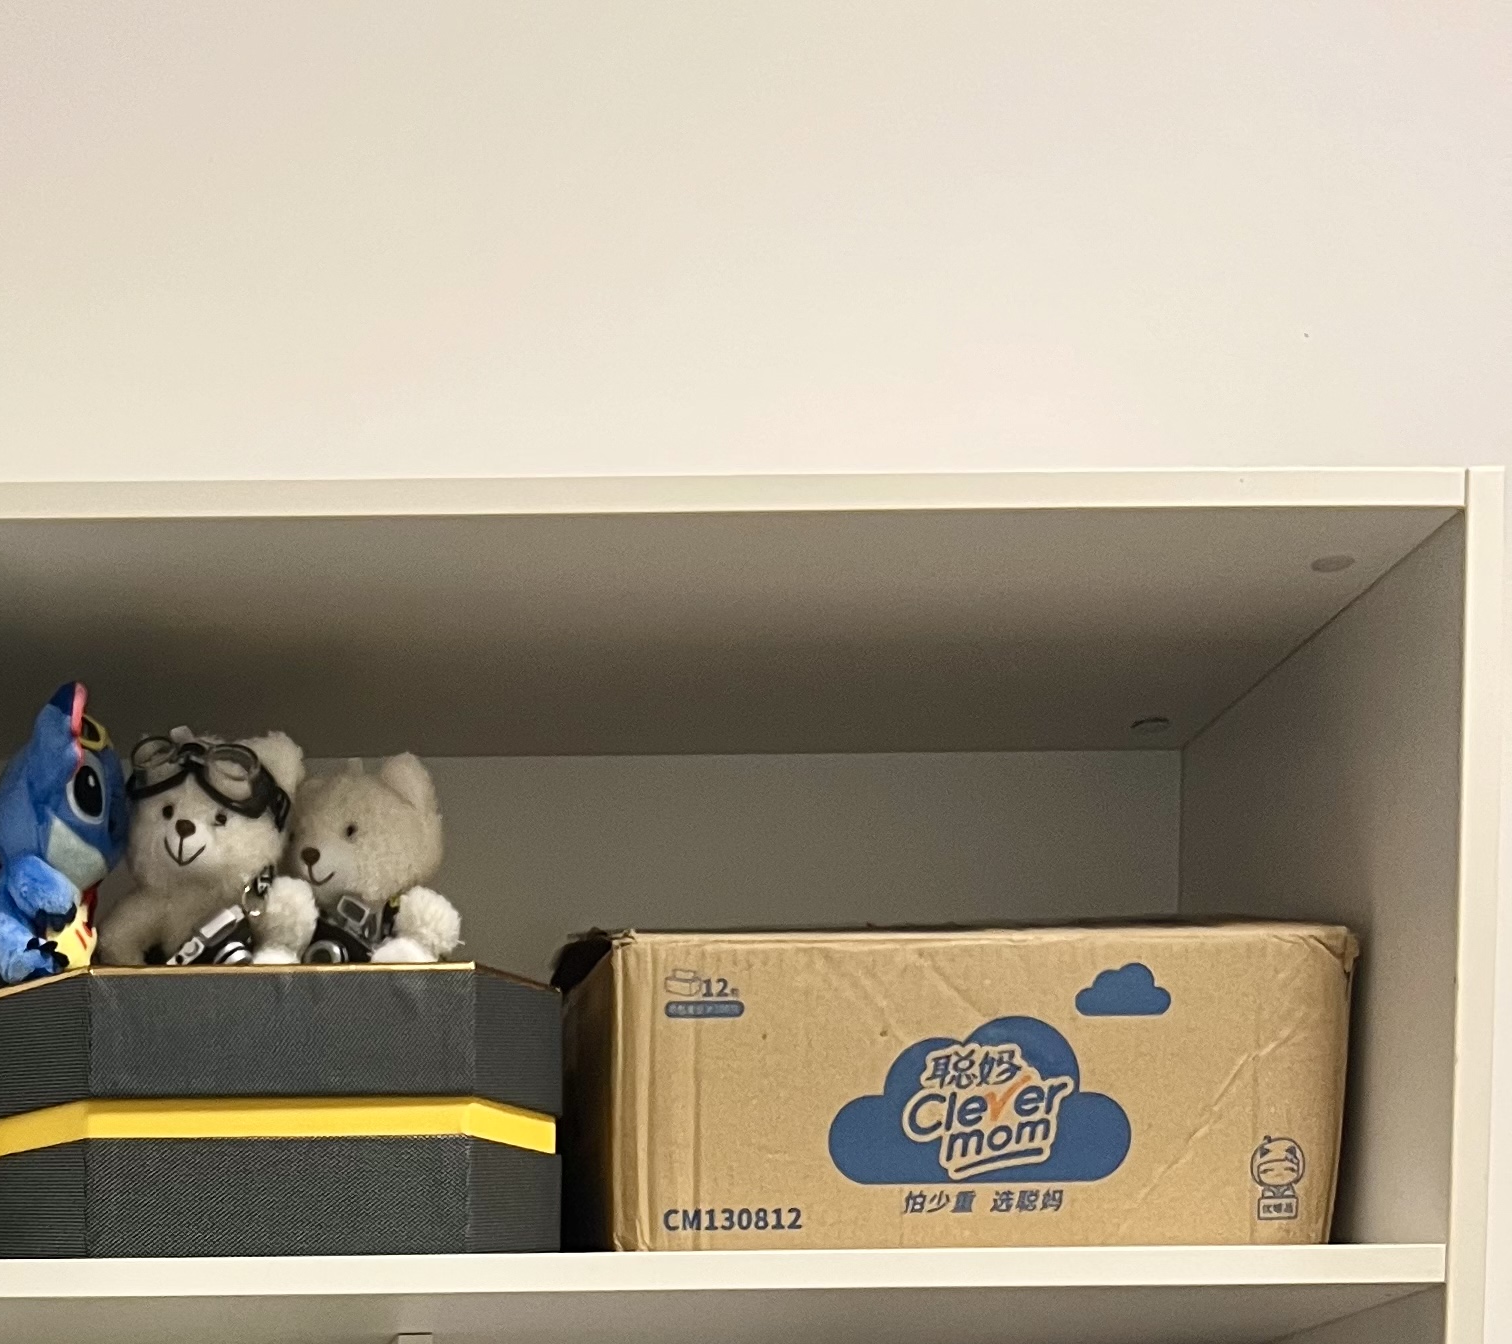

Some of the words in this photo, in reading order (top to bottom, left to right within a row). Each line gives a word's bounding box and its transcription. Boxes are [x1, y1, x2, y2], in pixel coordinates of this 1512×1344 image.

[928, 1049, 1022, 1087] 聪妈
[908, 1077, 1071, 1134] Clever
[946, 1117, 1052, 1162] mom
[663, 1206, 804, 1232] CM130812
